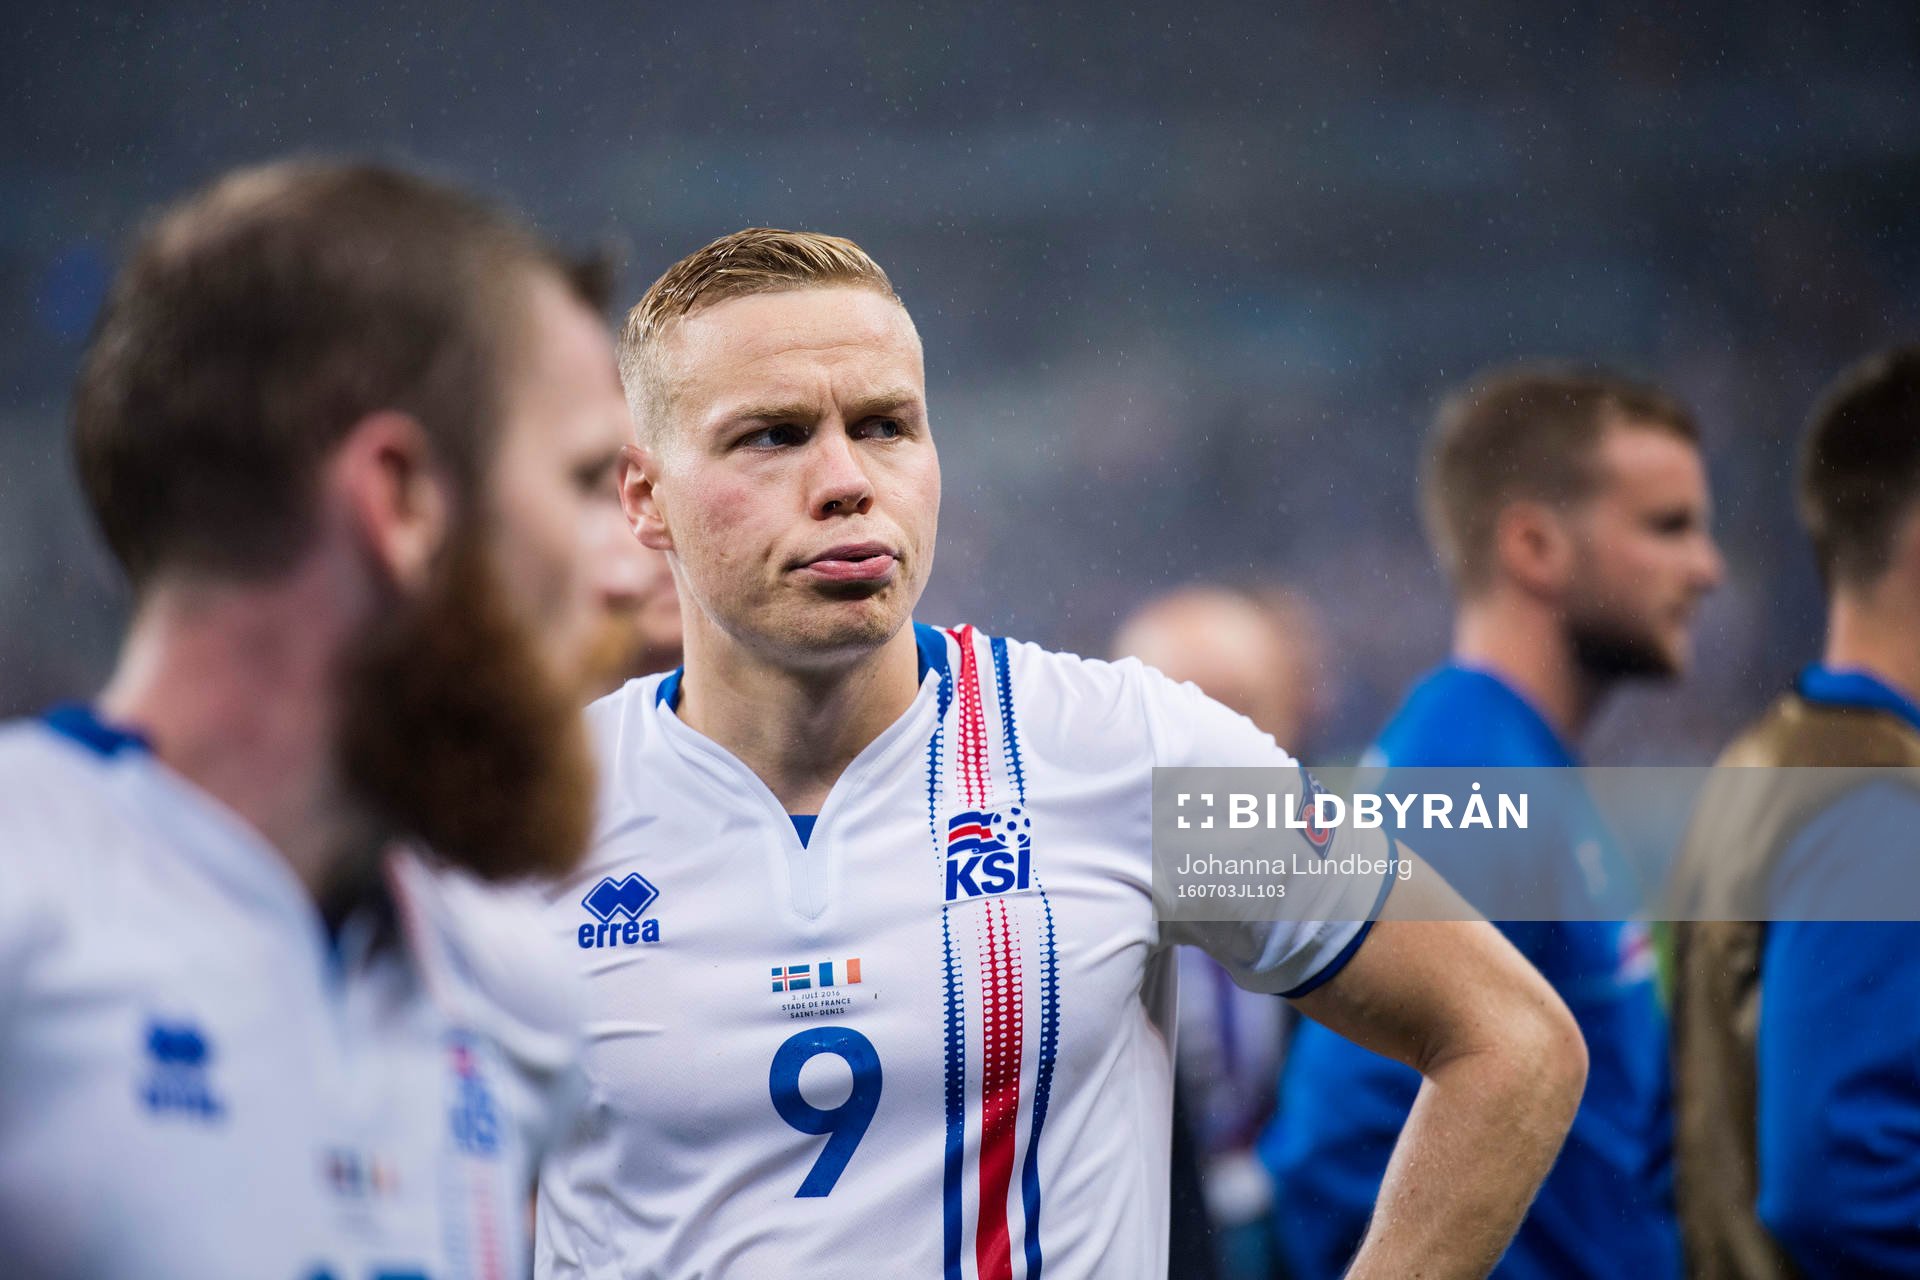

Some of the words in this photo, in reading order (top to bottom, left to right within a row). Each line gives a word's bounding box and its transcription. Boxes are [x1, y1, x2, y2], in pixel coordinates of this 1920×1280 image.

[802, 991, 818, 1000] JULI
[821, 990, 841, 998] 2016
[782, 1002, 806, 1011] STADE
[808, 1001, 818, 1009] DE
[821, 997, 851, 1007] FRANCE
[790, 1007, 845, 1019] SAINT-DENIS
[769, 1026, 883, 1198] 9
